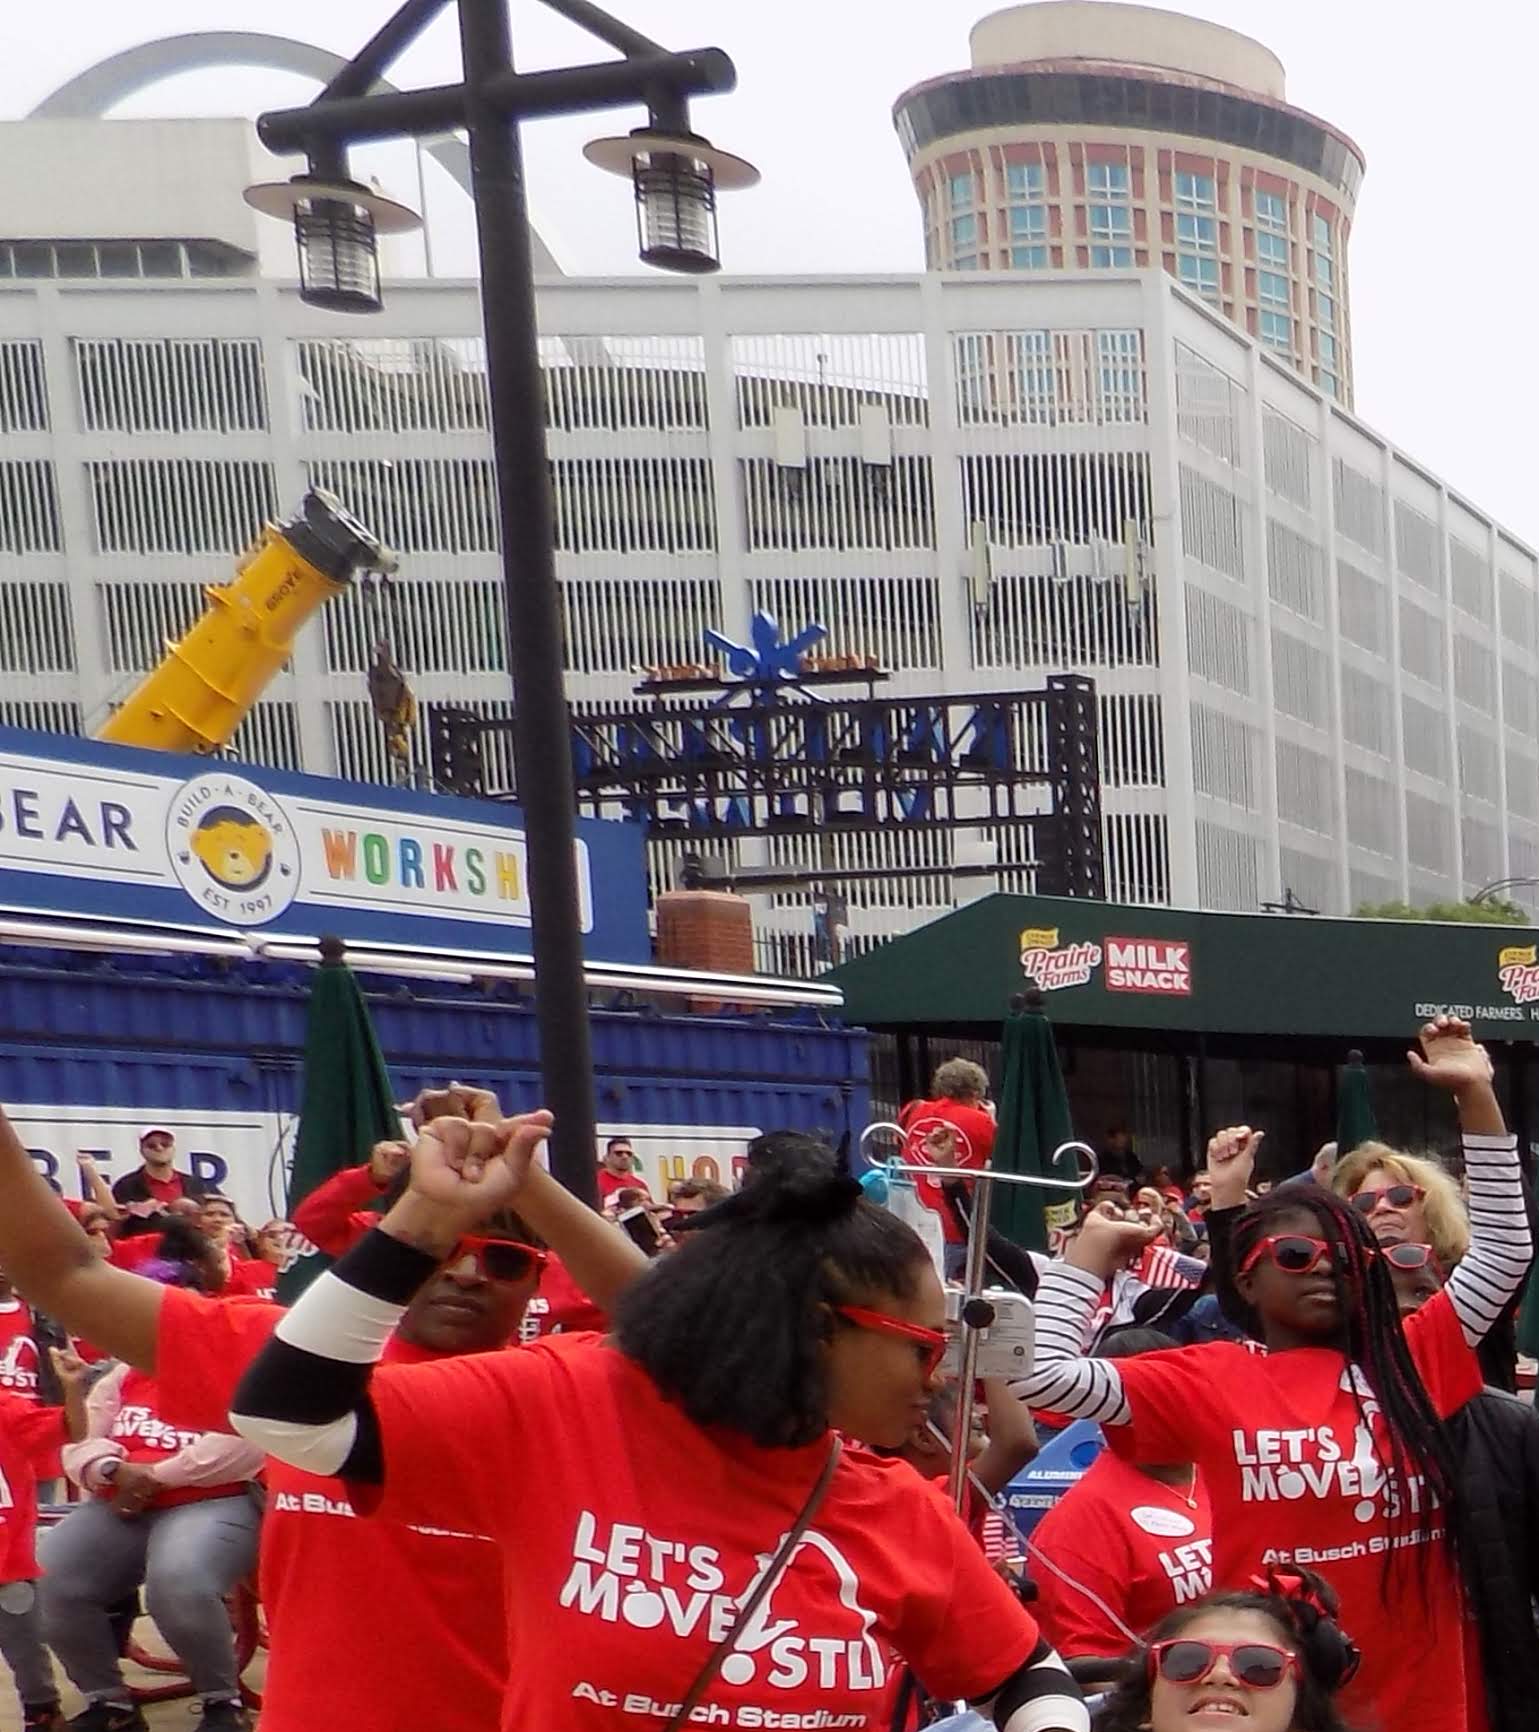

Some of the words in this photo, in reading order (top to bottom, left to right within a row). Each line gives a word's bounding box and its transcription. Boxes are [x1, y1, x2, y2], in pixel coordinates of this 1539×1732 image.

[0, 787, 139, 851] EAR
[321, 827, 520, 901] WORKSH
[203, 886, 230, 909] EST
[240, 894, 273, 916] 1997
[1021, 941, 1102, 978] Prairie
[1107, 943, 1190, 972] MILK
[1034, 966, 1091, 991] Farms
[1108, 969, 1191, 991] SNACK
[1414, 1003, 1474, 1019] DEDICATED
[1233, 1425, 1341, 1465] LET'S
[274, 1493, 301, 1512] At
[573, 1510, 725, 1592] LET'S
[1262, 1549, 1291, 1565] At
[1294, 1541, 1367, 1564] Busch
[767, 1636, 874, 1691] STL
[572, 1681, 618, 1707] At
[737, 1705, 867, 1730] Stadium
